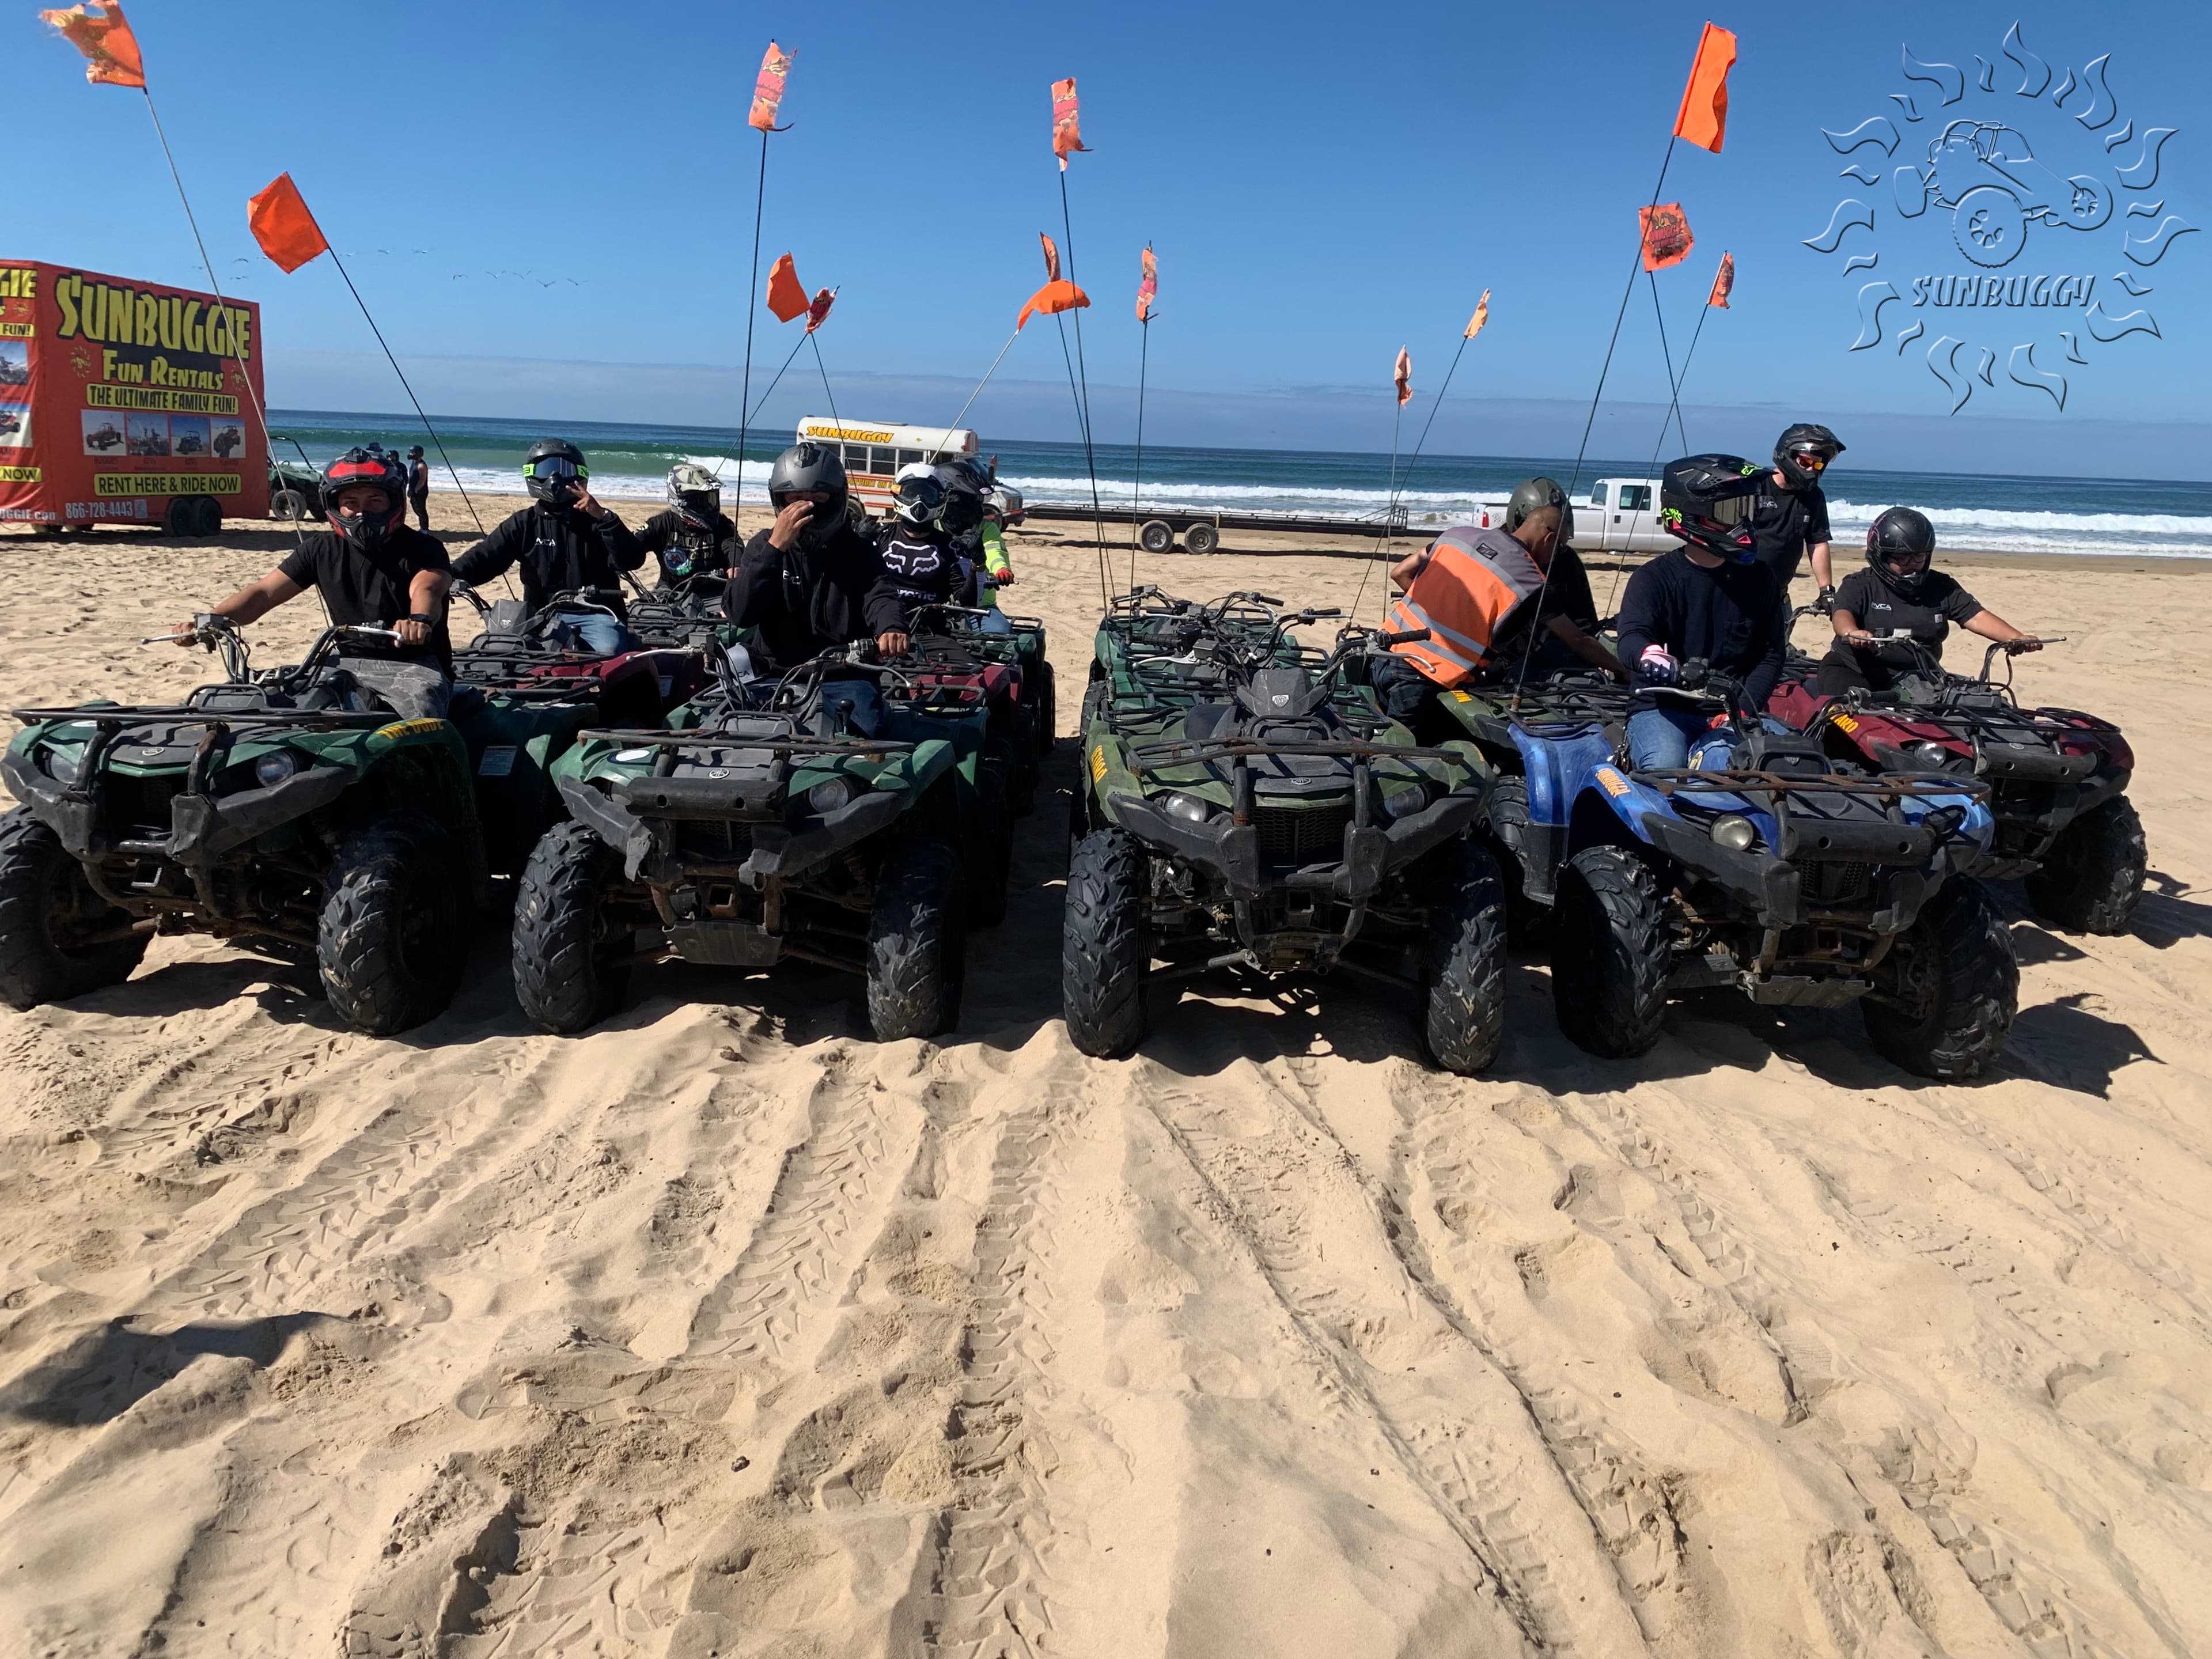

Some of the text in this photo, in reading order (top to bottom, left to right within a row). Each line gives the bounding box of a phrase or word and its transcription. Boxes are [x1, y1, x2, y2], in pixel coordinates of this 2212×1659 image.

[56, 275, 250, 359] SUNBUGGIE
[3, 324, 31, 336] FUN!
[90, 385, 236, 413] THE ULTIMATE FAMILY FUN!
[806, 426, 894, 443] SUNBUGGY
[3, 469, 37, 481] NOW
[99, 477, 238, 494] RENT HERE & RIDE NOW
[65, 501, 133, 518] 866-728-4443
